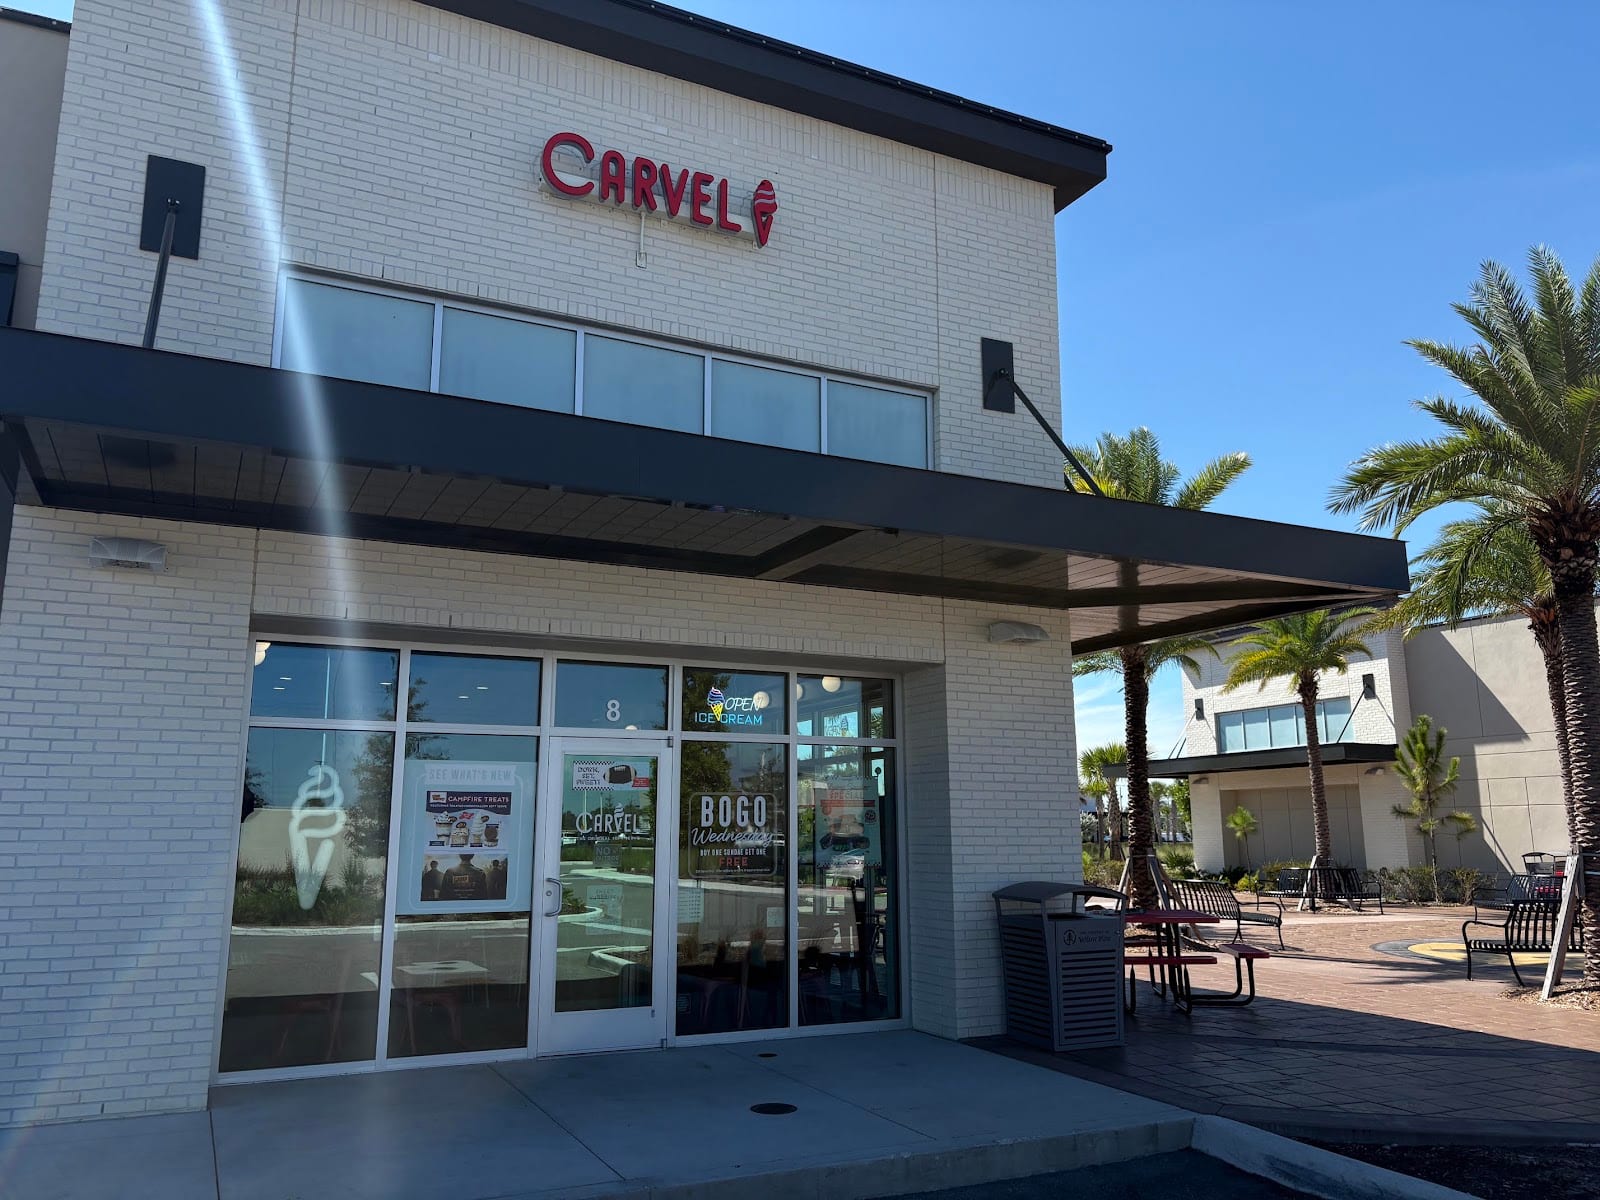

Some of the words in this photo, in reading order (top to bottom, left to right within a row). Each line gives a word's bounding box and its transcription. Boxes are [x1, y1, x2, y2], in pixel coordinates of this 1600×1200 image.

[541, 132, 742, 233] CARVEL
[606, 699, 621, 722] 8
[724, 697, 761, 712] OPEN
[694, 711, 715, 723] ICE
[720, 713, 762, 726] CREAM
[428, 768, 447, 780] SEE
[450, 768, 488, 781] WHAT'S
[490, 769, 512, 782] NEW
[484, 796, 509, 804] TREATS
[700, 795, 767, 828] BOGO
[576, 809, 641, 835] CARVEL
[691, 827, 774, 848] Wednesday
[700, 848, 711, 856] BUY
[712, 848, 722, 856] ONE
[723, 848, 744, 856] SUNDAE
[745, 848, 755, 856] GET
[756, 848, 767, 856] ONE
[719, 856, 749, 867] FREE
